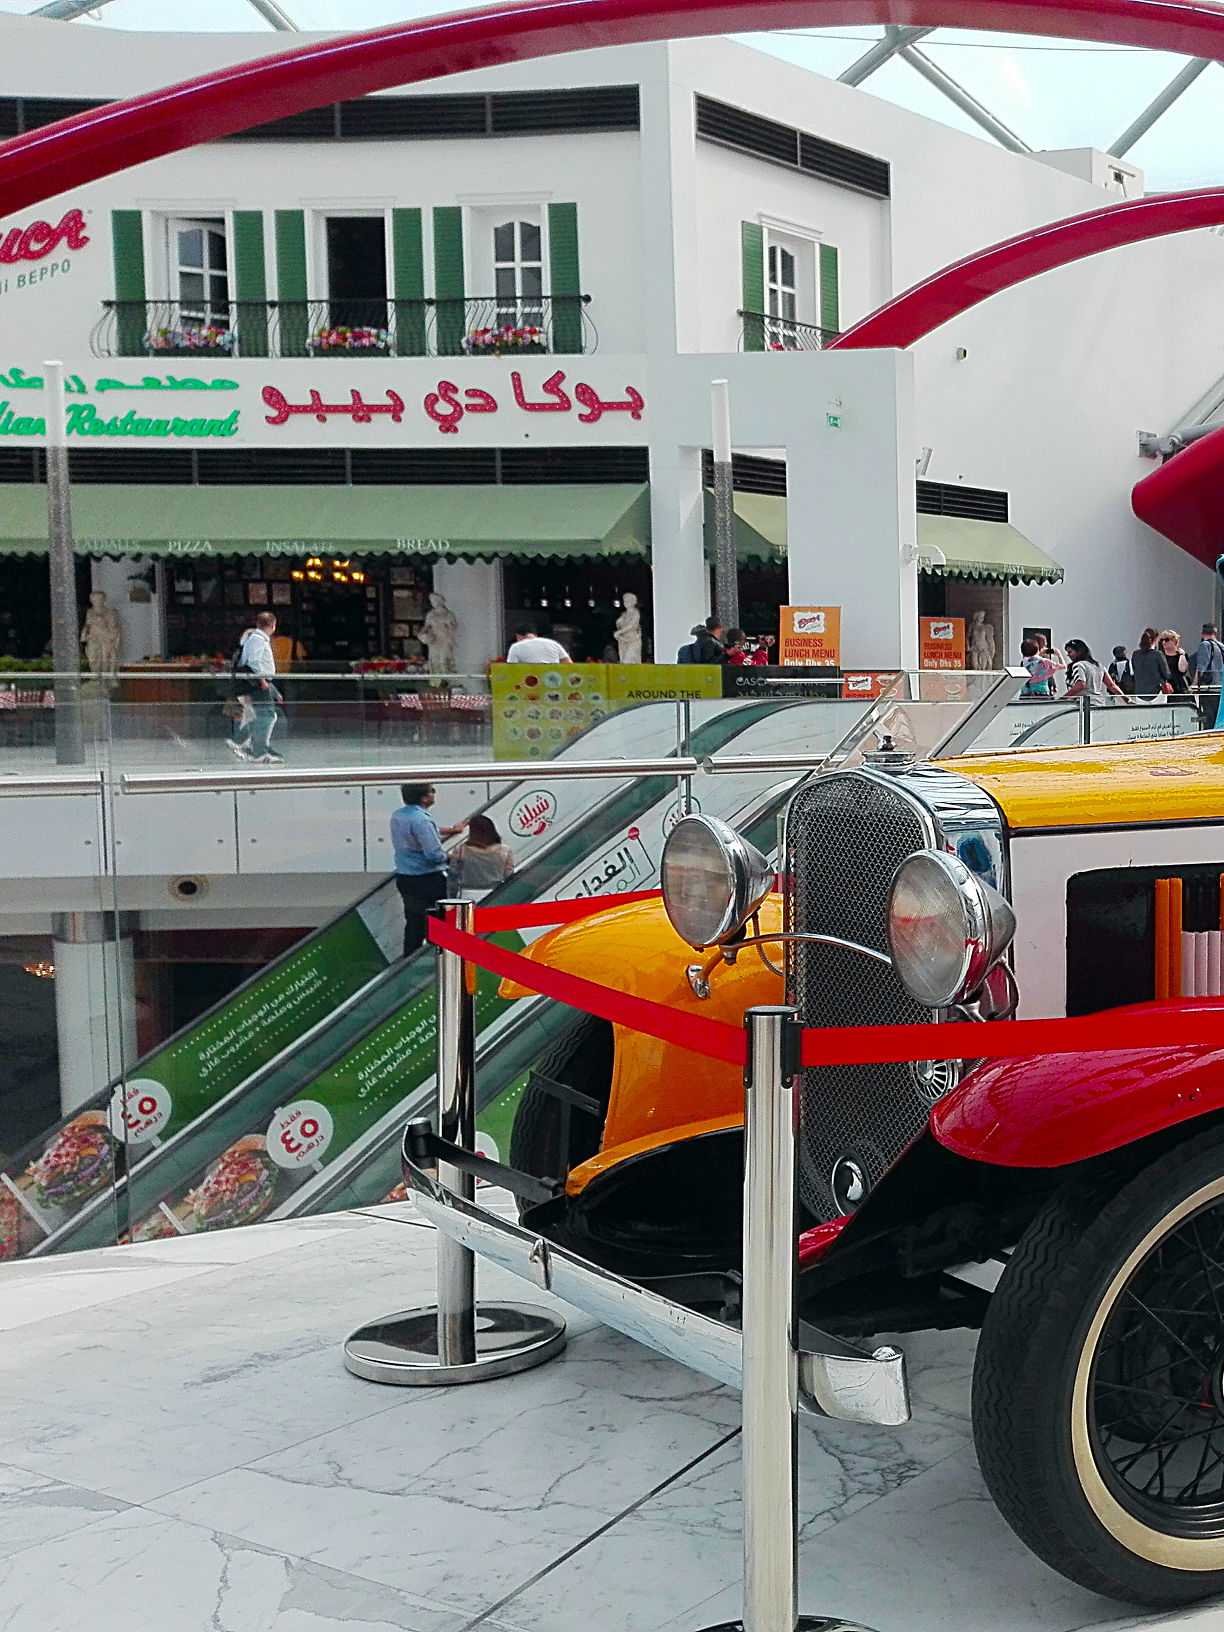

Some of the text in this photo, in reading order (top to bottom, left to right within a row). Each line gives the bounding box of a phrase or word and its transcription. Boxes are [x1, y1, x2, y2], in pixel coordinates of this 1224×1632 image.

[16, 259, 71, 288] BEPPO
[261, 370, 645, 434] بوكا دي بيبو
[65, 404, 241, 437] Restaurant
[167, 541, 214, 552] PIZZA
[397, 538, 450, 551] BREAD
[1003, 564, 1025, 574] PASTA
[784, 638, 823, 647] BUSINESS
[924, 642, 953, 651] BUSINESS
[784, 649, 835, 658] LUNCH MENU
[924, 651, 962, 659] LUNCH MENU
[923, 658, 962, 668] Only Dhs 35
[627, 690, 702, 699] AROUND THE
